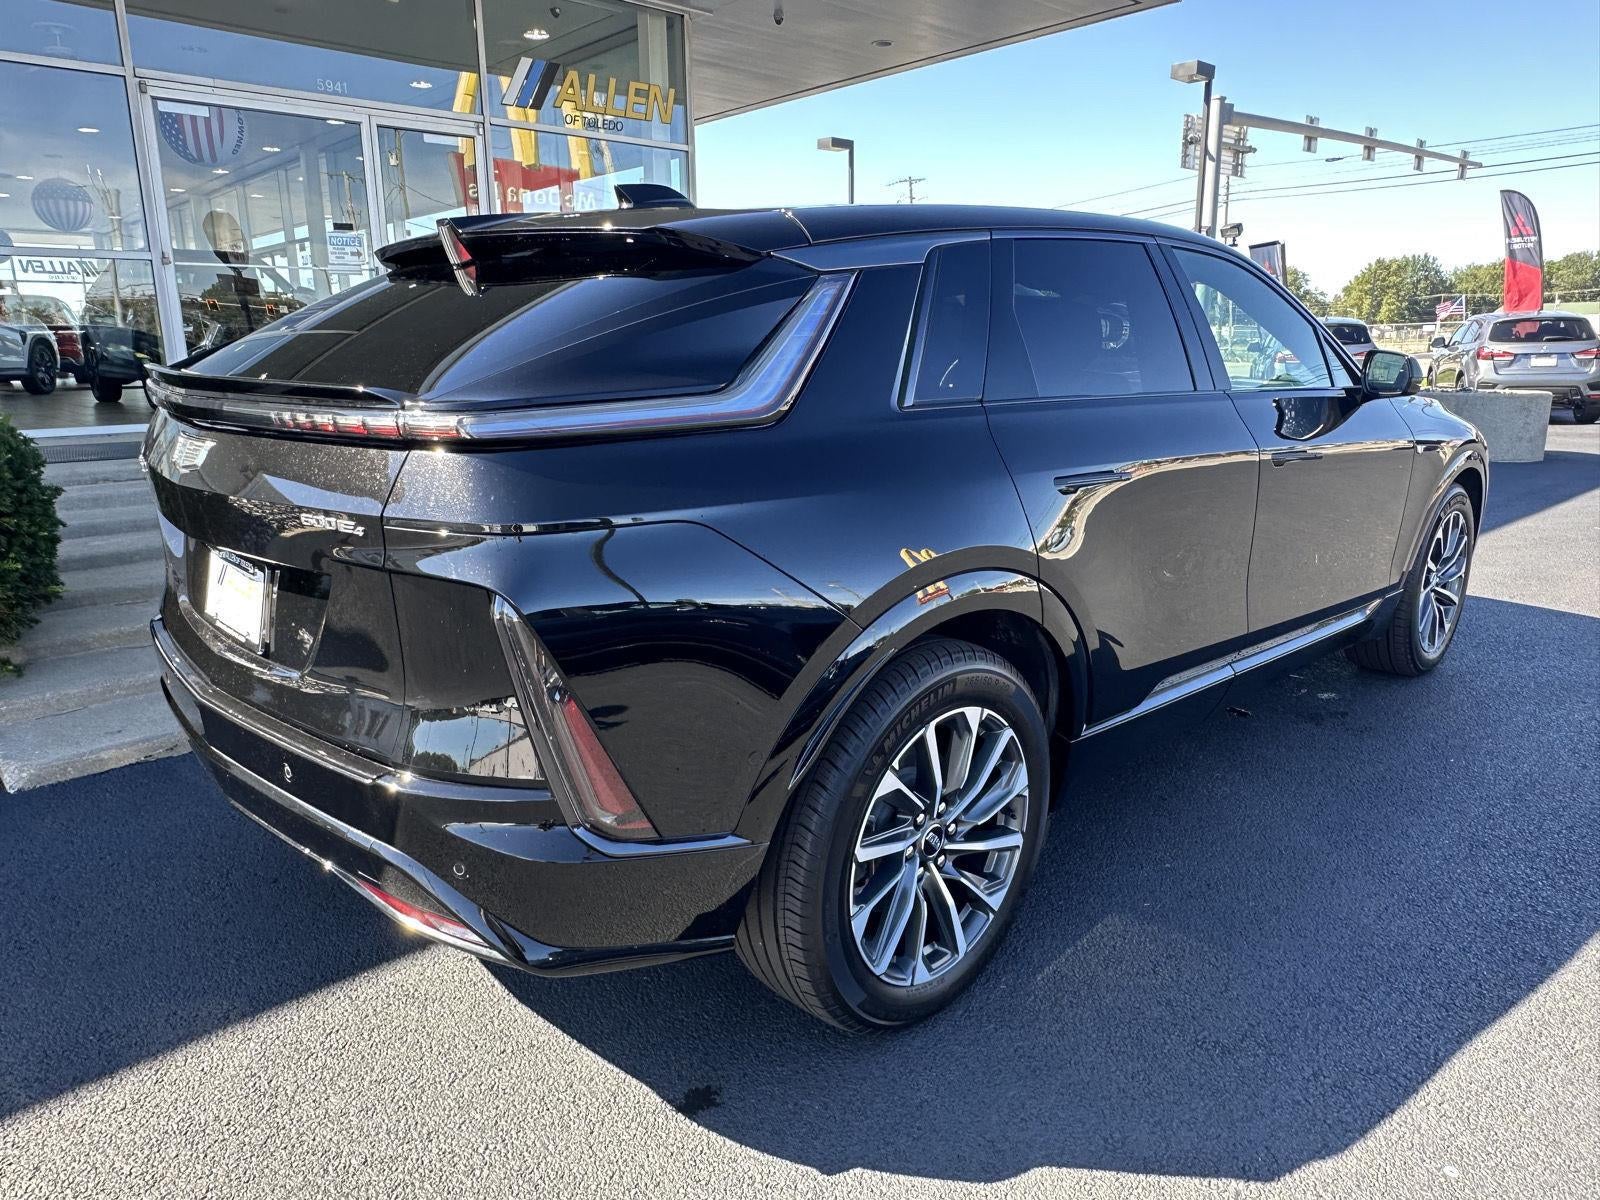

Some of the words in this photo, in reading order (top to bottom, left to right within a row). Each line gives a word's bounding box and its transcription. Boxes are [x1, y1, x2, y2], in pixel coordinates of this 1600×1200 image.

[316, 78, 348, 94] 5941
[553, 69, 676, 124] ALLEN
[564, 114, 580, 126] OF
[583, 116, 624, 132] TOLEDO
[330, 237, 360, 247] NOTICE
[882, 681, 956, 749] MICHELIN
